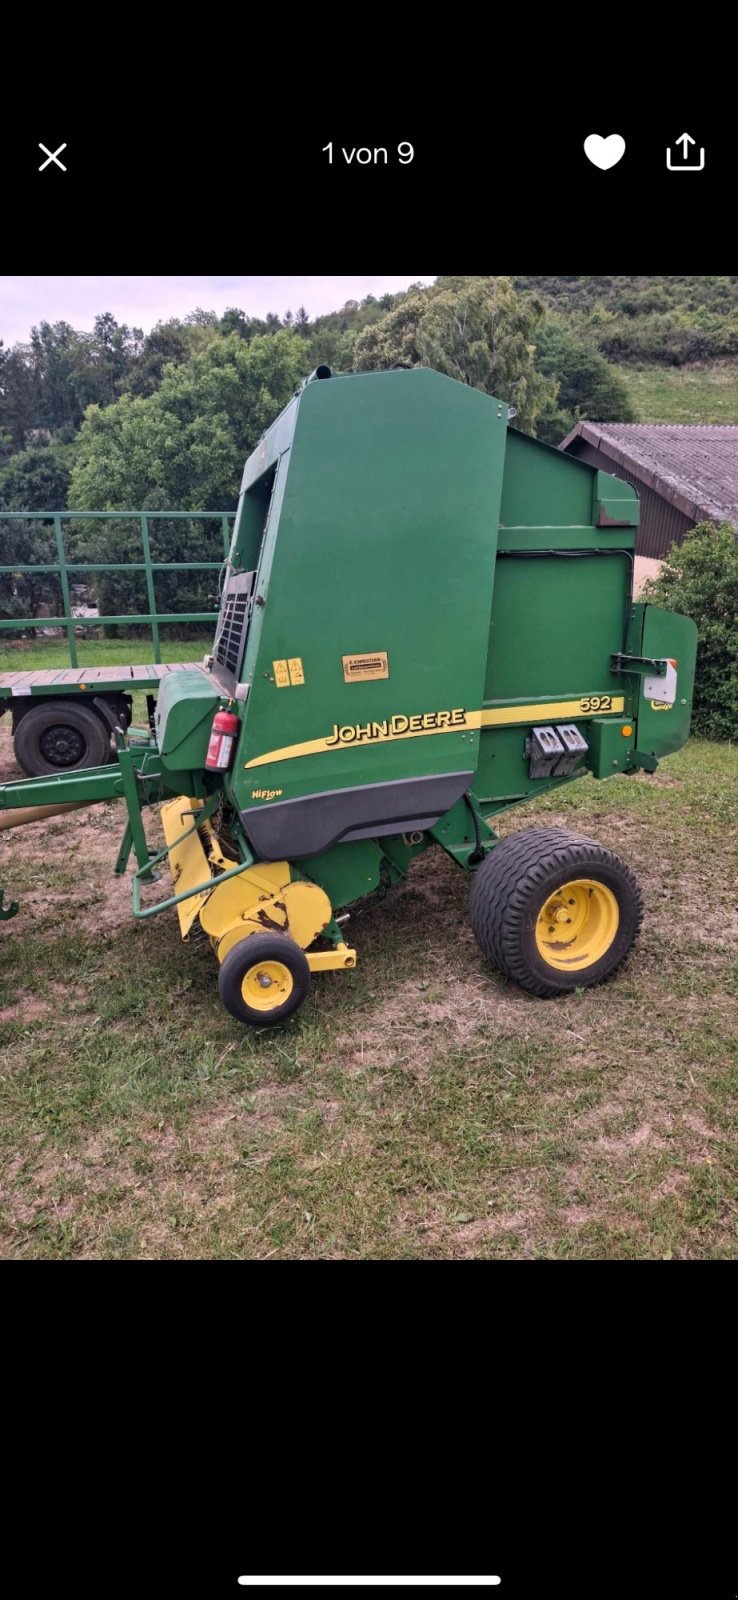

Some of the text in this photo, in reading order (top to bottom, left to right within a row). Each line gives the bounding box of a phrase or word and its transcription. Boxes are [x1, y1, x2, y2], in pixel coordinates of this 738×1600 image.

[580, 696, 611, 712] 592
[326, 708, 467, 746] JOHN DEERE
